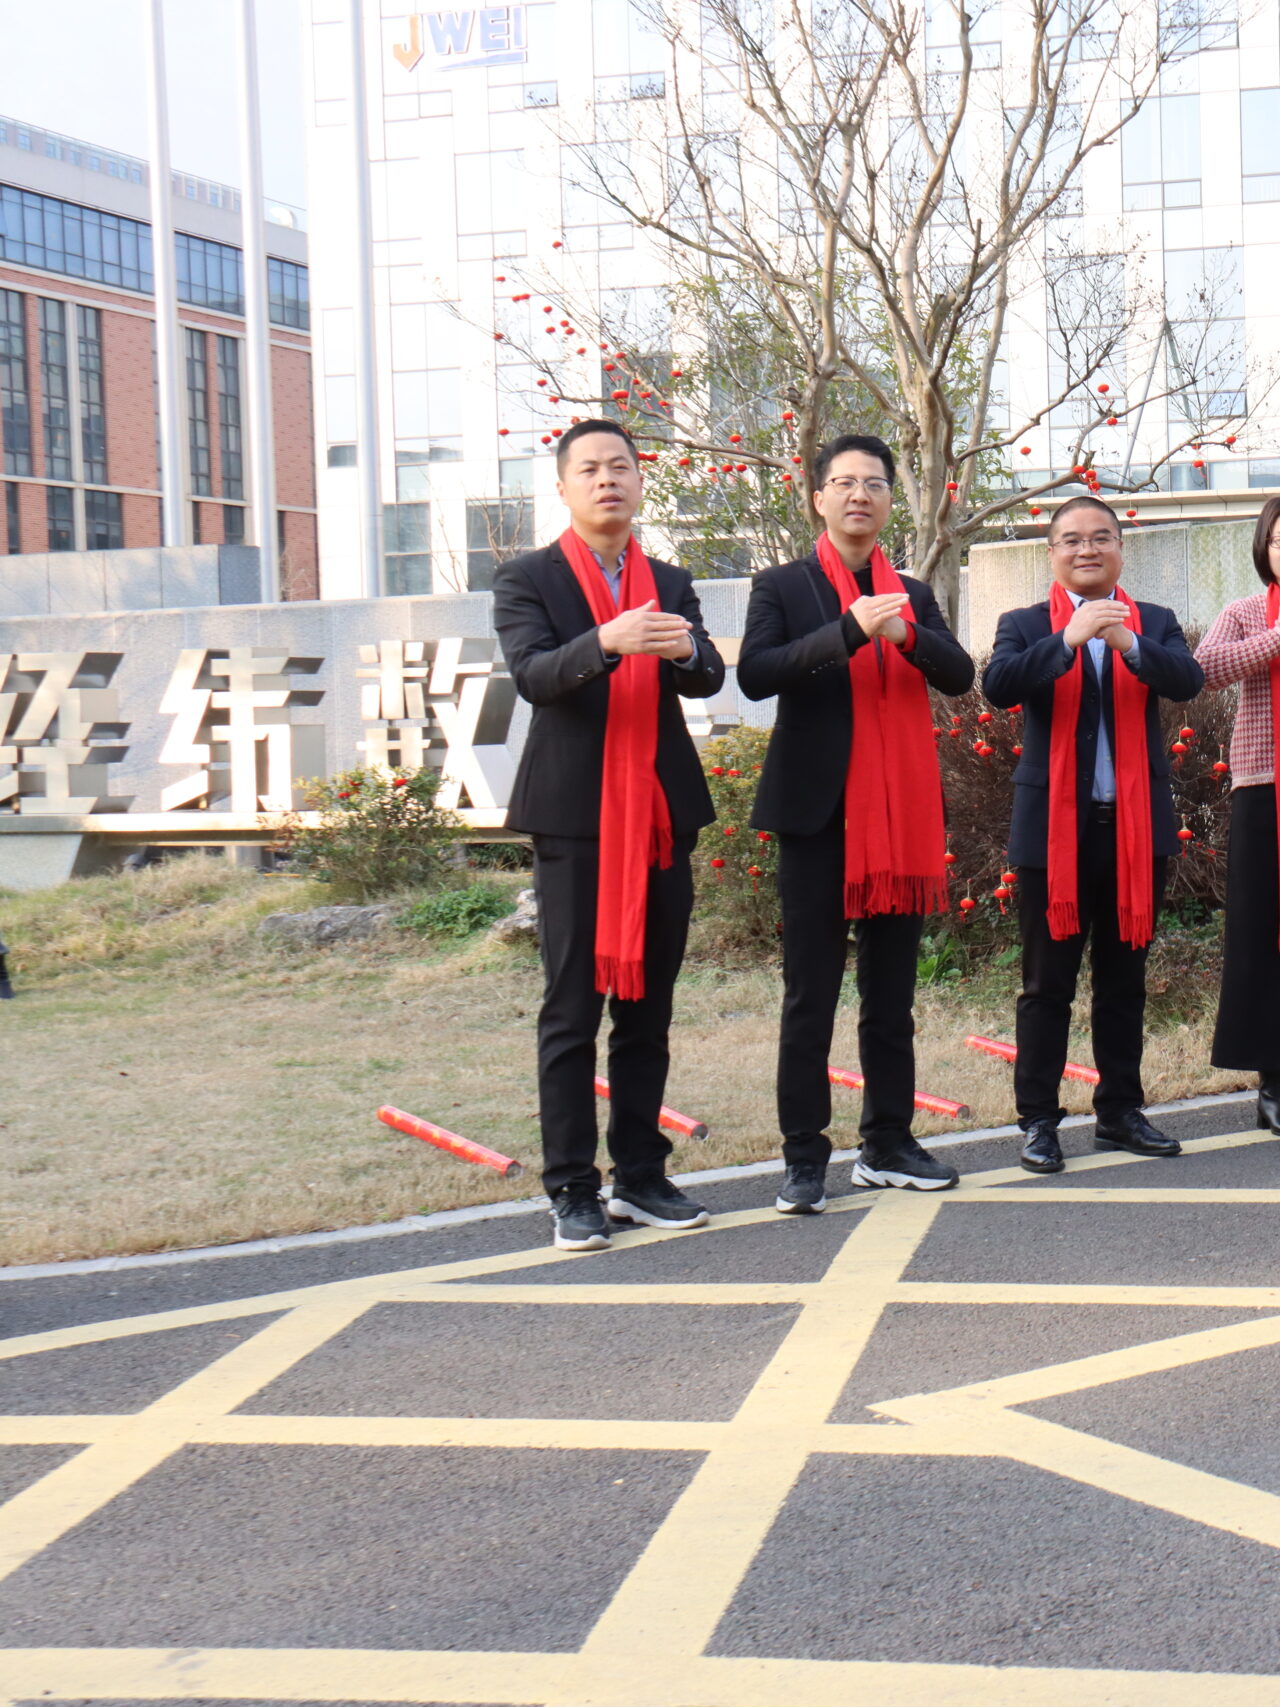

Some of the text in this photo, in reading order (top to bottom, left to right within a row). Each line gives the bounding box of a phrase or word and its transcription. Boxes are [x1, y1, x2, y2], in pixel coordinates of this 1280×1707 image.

[393, 7, 527, 72] JWEI
[0, 637, 736, 812] 经纬数
